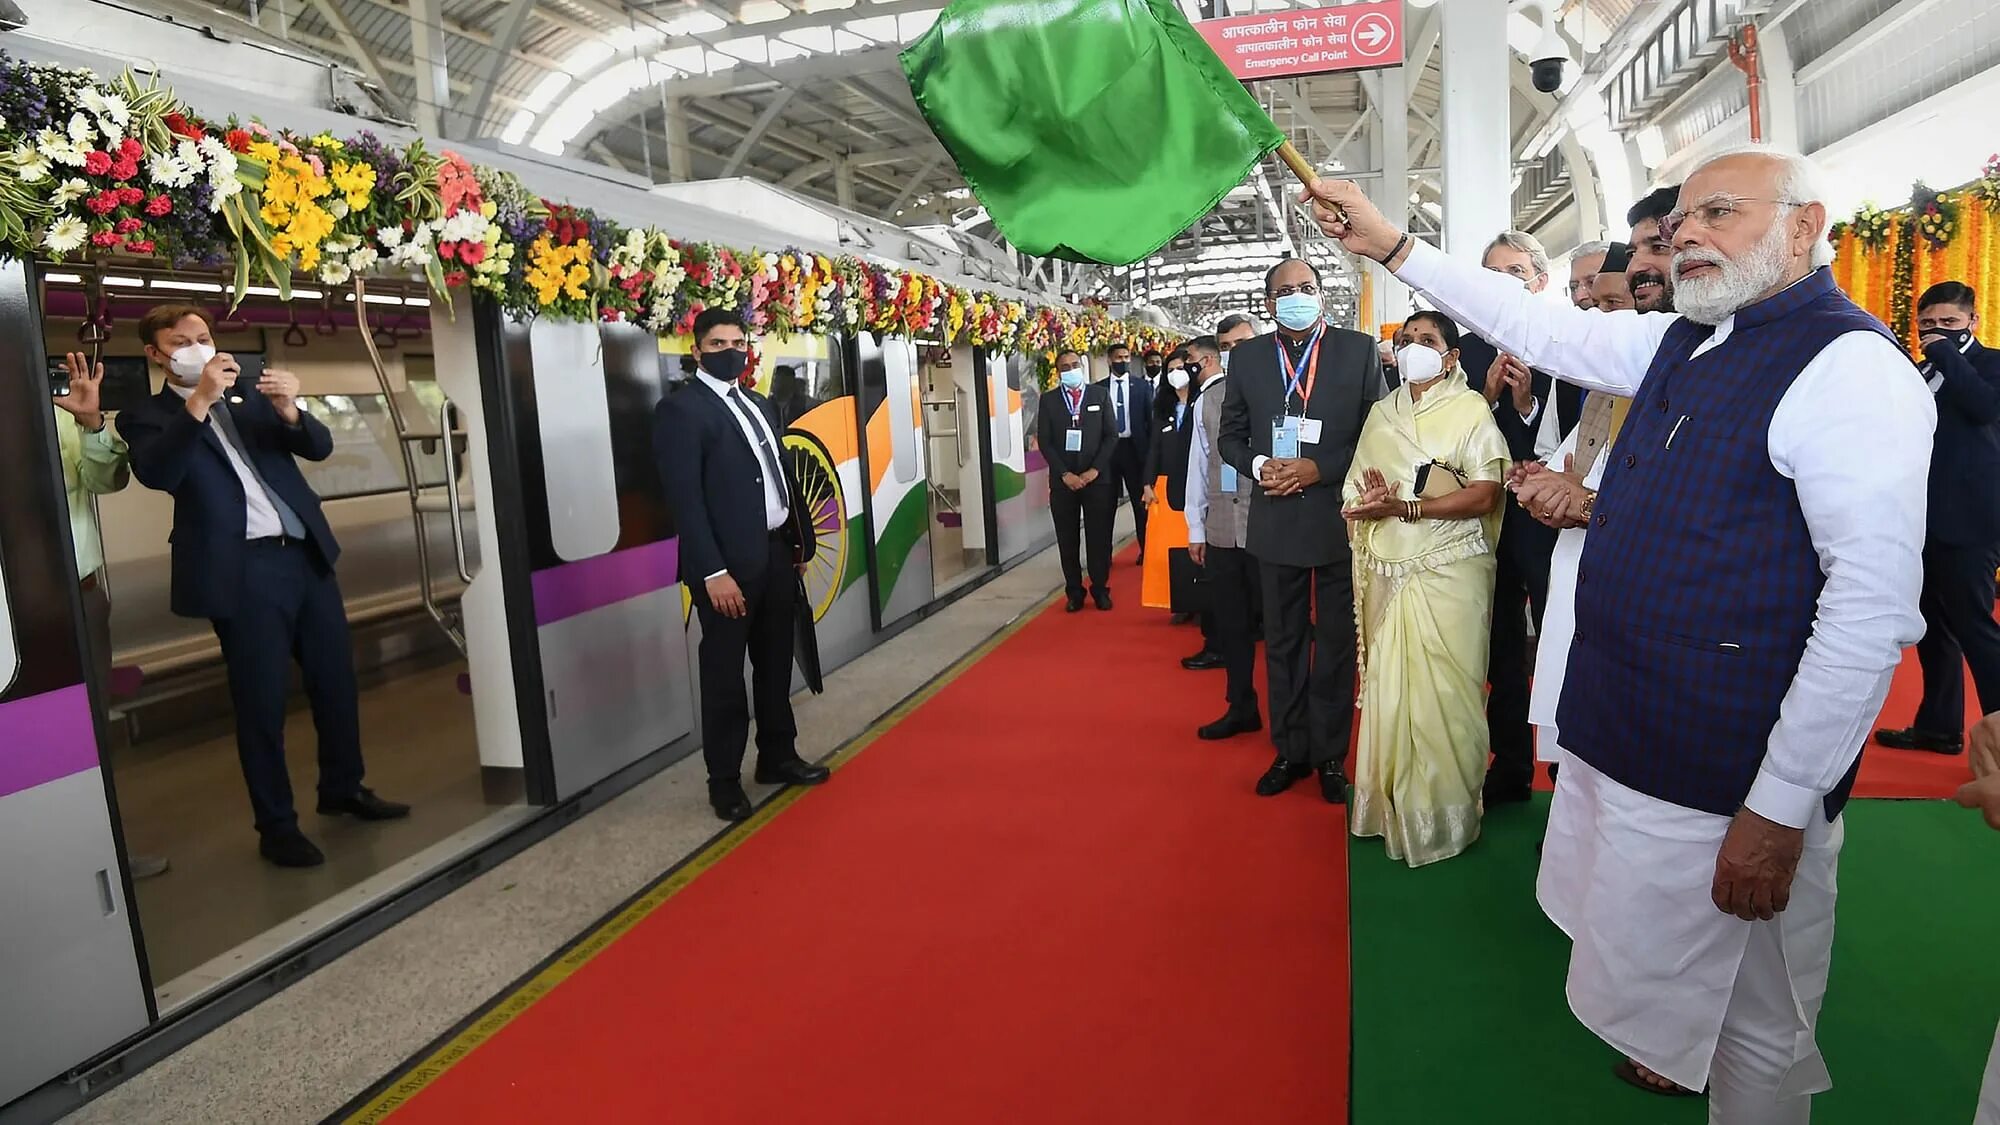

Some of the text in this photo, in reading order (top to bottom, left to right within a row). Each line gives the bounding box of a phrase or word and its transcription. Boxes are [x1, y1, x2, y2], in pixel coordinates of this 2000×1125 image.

[1293, 16, 1317, 31] फोन
[1323, 13, 1346, 27] सेवा
[1235, 32, 1347, 54] आपातकालीन फोन सेवा
[1245, 50, 1348, 69] Emergency Call Point
